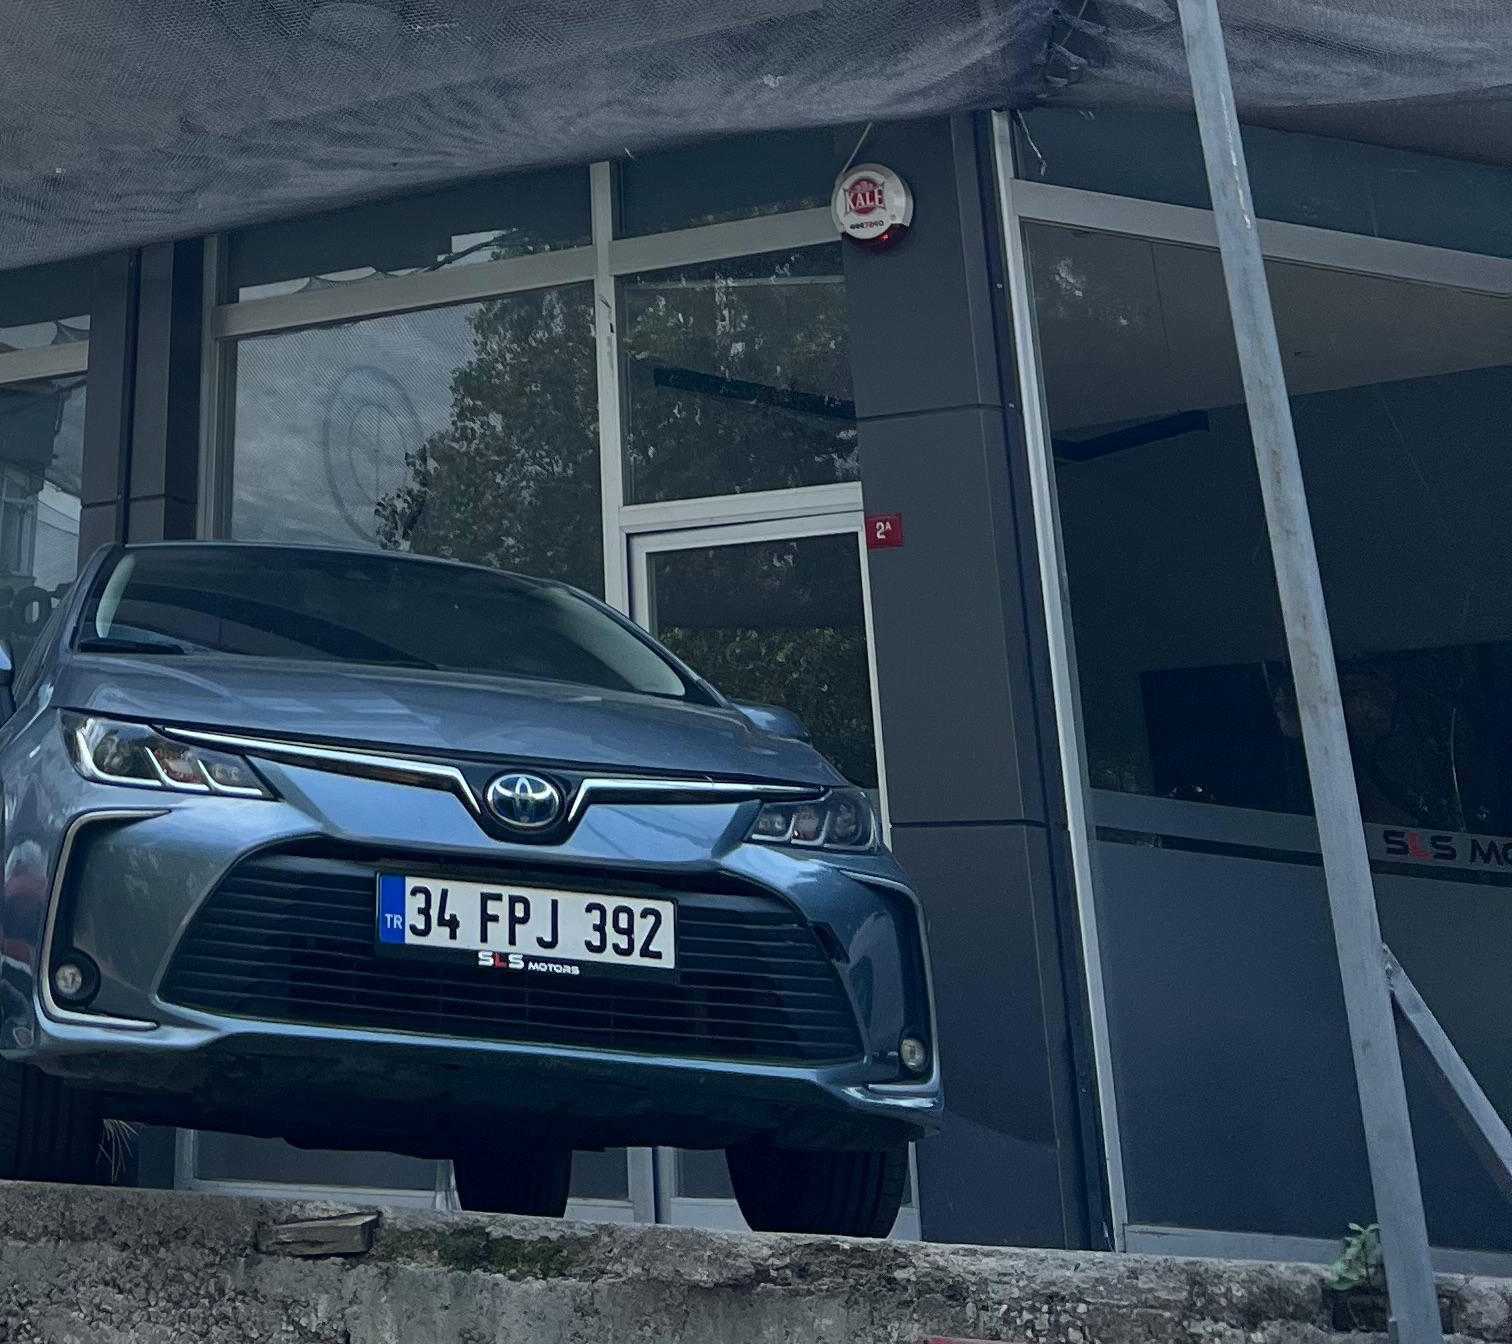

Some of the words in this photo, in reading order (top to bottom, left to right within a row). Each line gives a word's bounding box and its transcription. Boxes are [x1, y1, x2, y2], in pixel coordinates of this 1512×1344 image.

[845, 186, 886, 213] KALE
[1383, 829, 1457, 862] SLS
[384, 913, 403, 930] TR
[408, 885, 460, 941] 34
[478, 891, 560, 950] FPJ
[584, 901, 664, 960] 392
[477, 950, 526, 970] SLS
[527, 961, 581, 976] MOTORS
